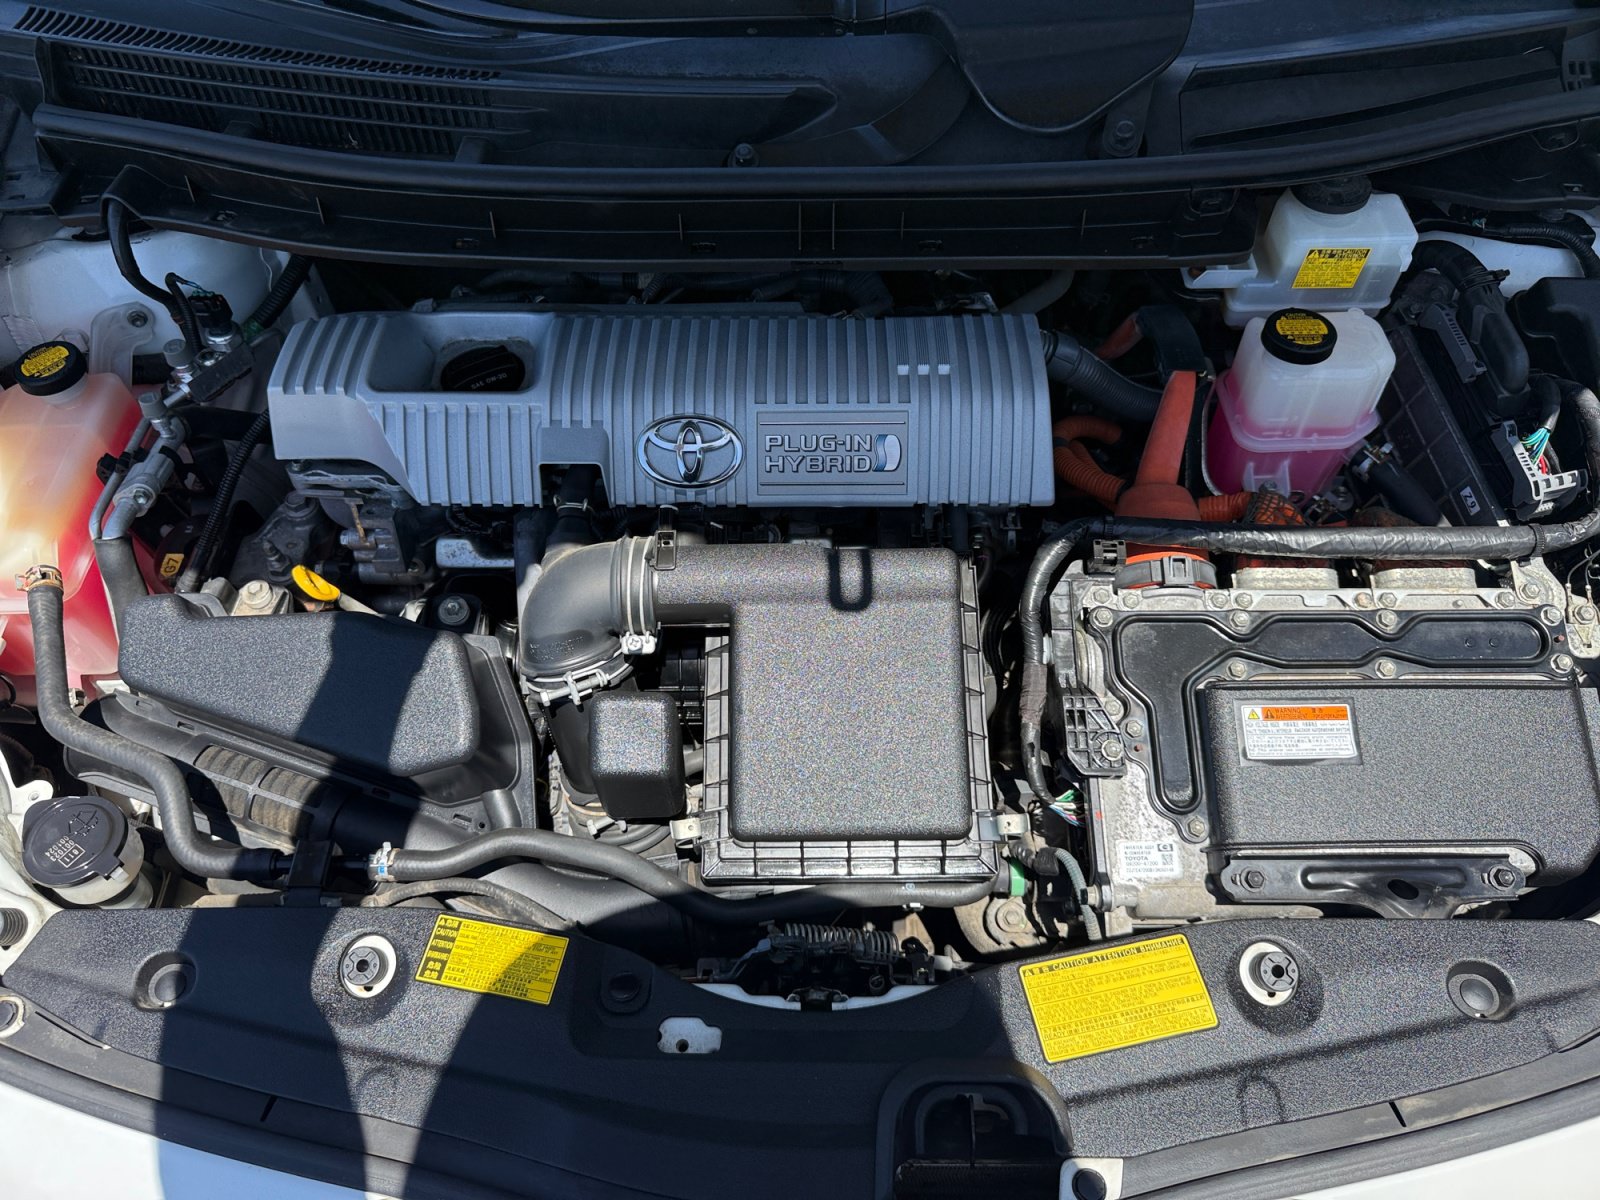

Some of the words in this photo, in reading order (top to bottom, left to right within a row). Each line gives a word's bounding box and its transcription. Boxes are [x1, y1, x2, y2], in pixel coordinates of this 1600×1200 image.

[471, 380, 485, 390] SAE
[765, 434, 873, 452] PLUG-IN
[765, 455, 872, 473] HYBRID
[164, 557, 179, 574] G7
[44, 835, 71, 857] 001024
[49, 839, 76, 862] 001023
[435, 927, 458, 938] CAUTION
[1052, 957, 1089, 971] CAUTION
[1091, 947, 1138, 963] ATTENTION
[1139, 938, 1184, 953] ВНИМАНИЕ
